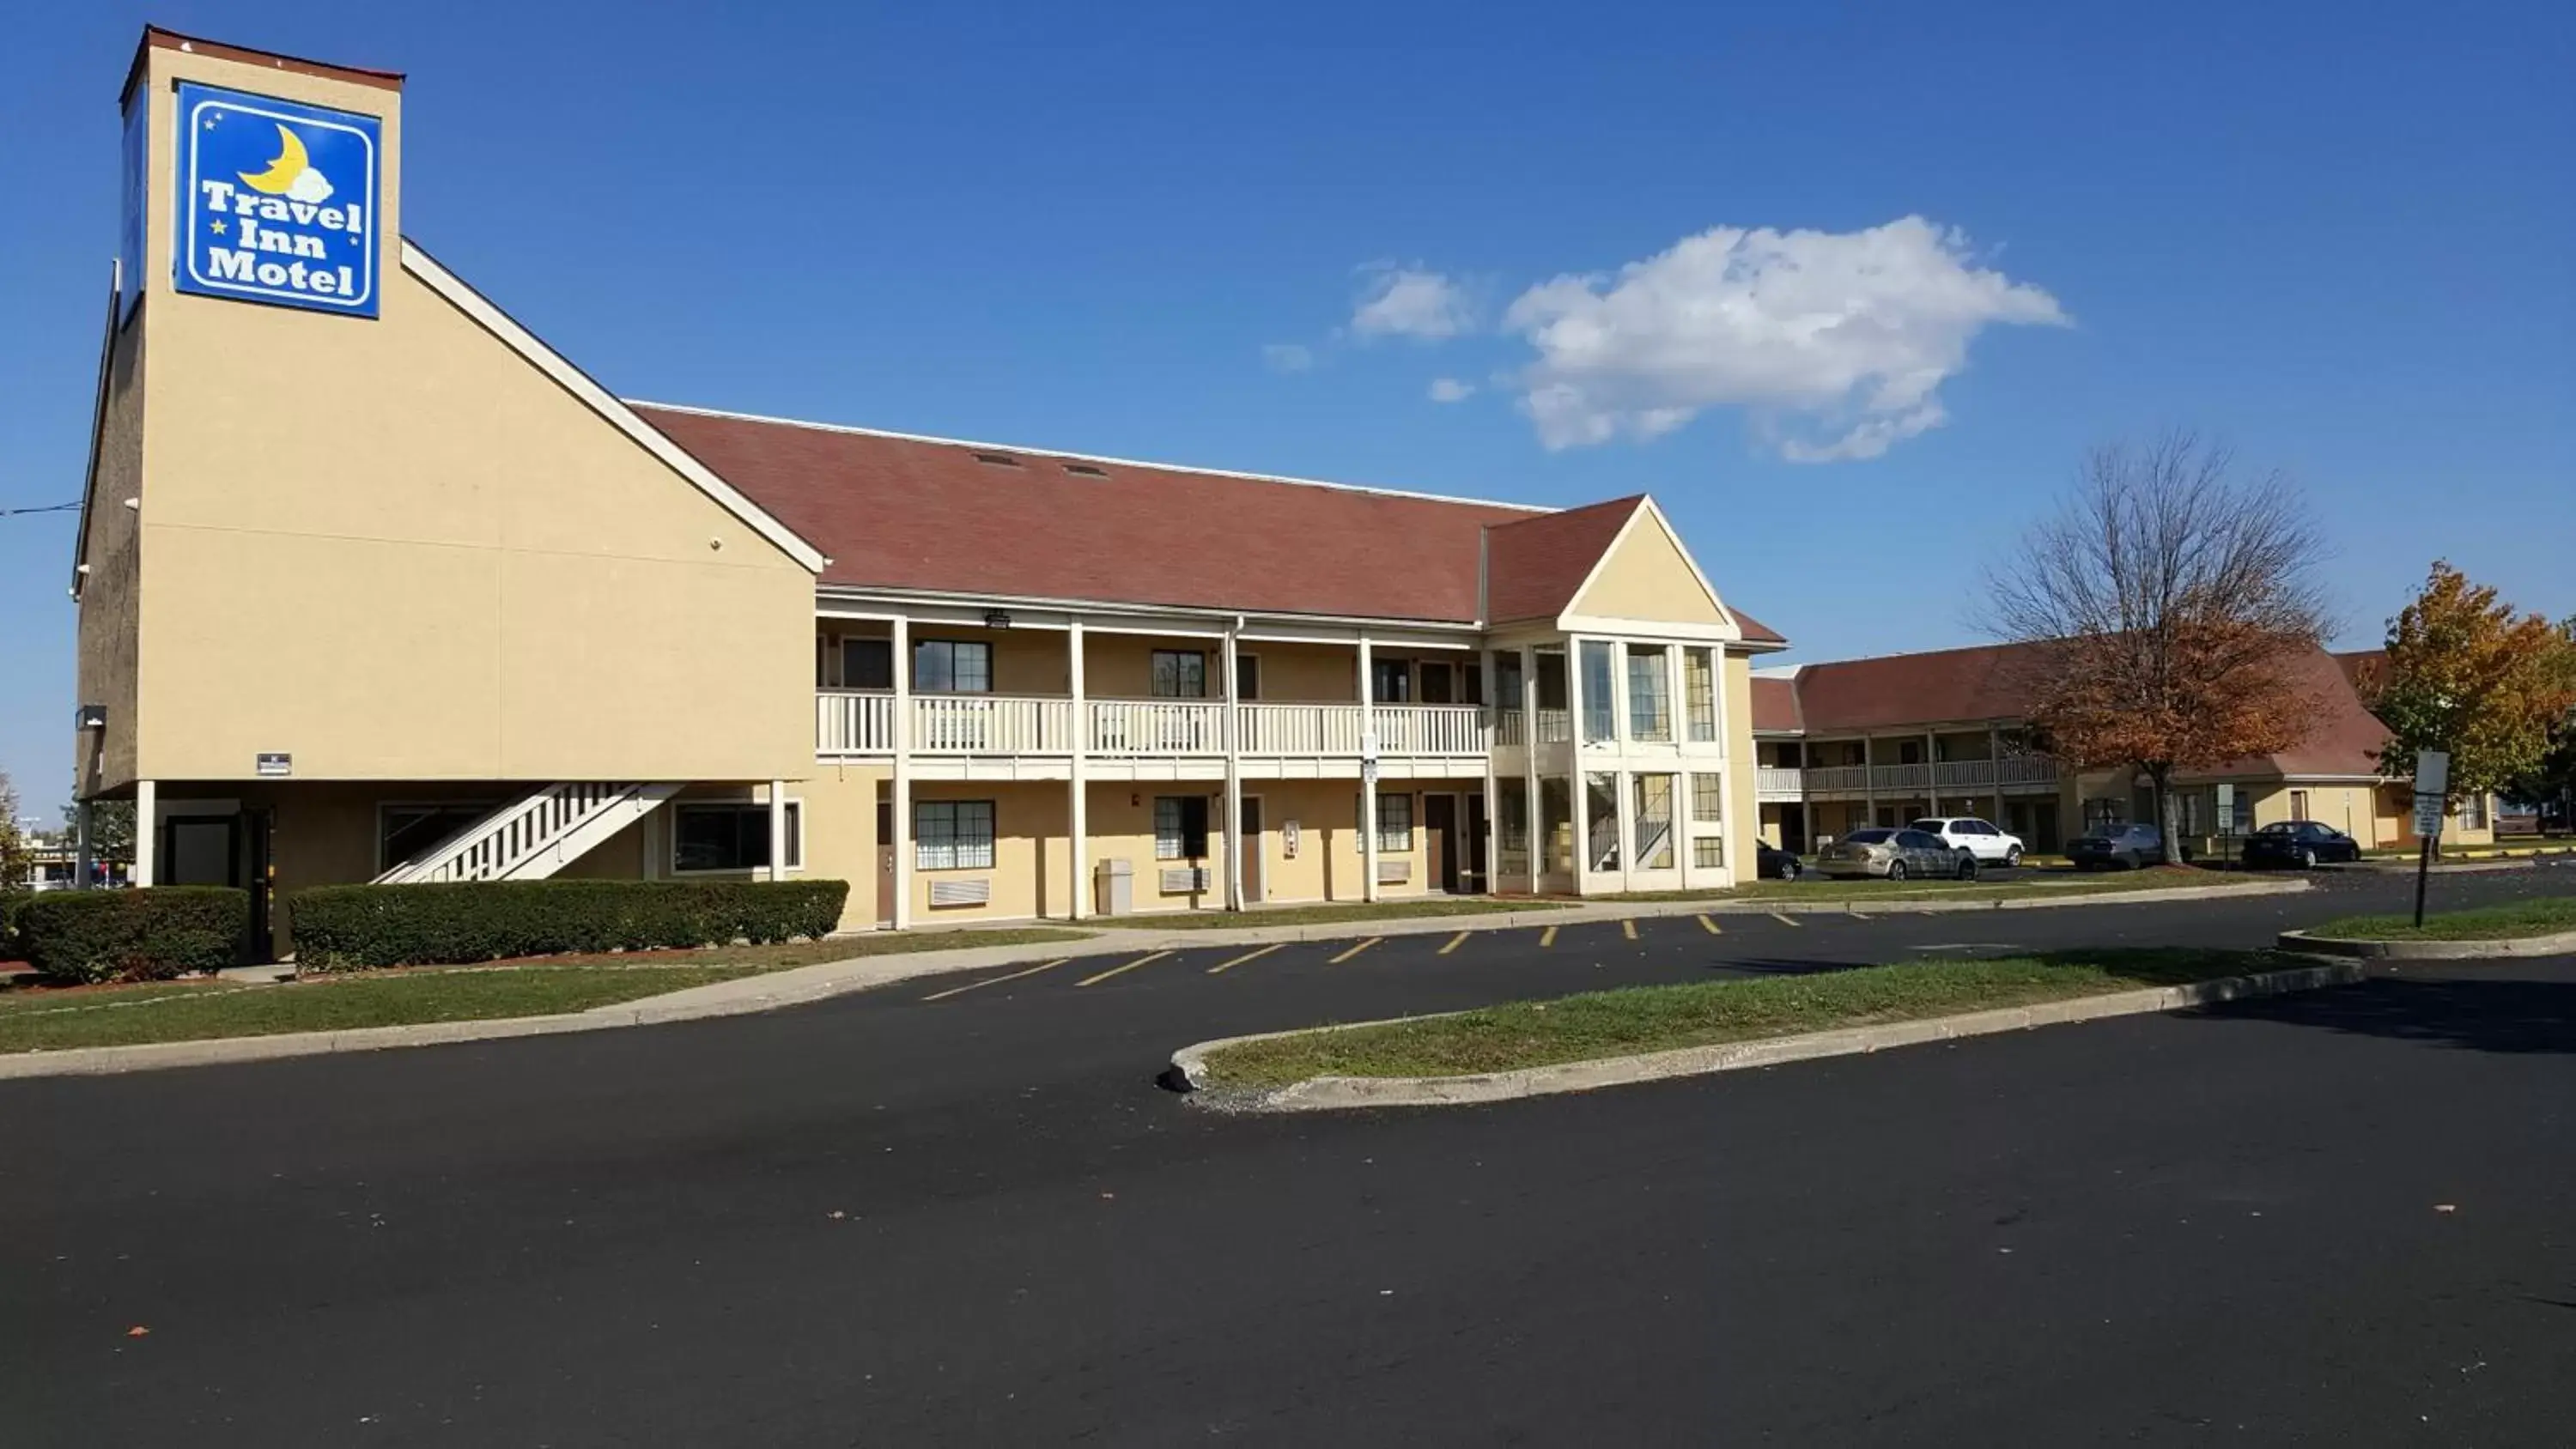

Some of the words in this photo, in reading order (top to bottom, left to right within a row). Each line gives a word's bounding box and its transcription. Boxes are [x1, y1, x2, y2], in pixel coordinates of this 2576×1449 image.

[202, 179, 361, 233] Travel
[239, 218, 326, 259] Inn
[209, 247, 354, 296] Motel
